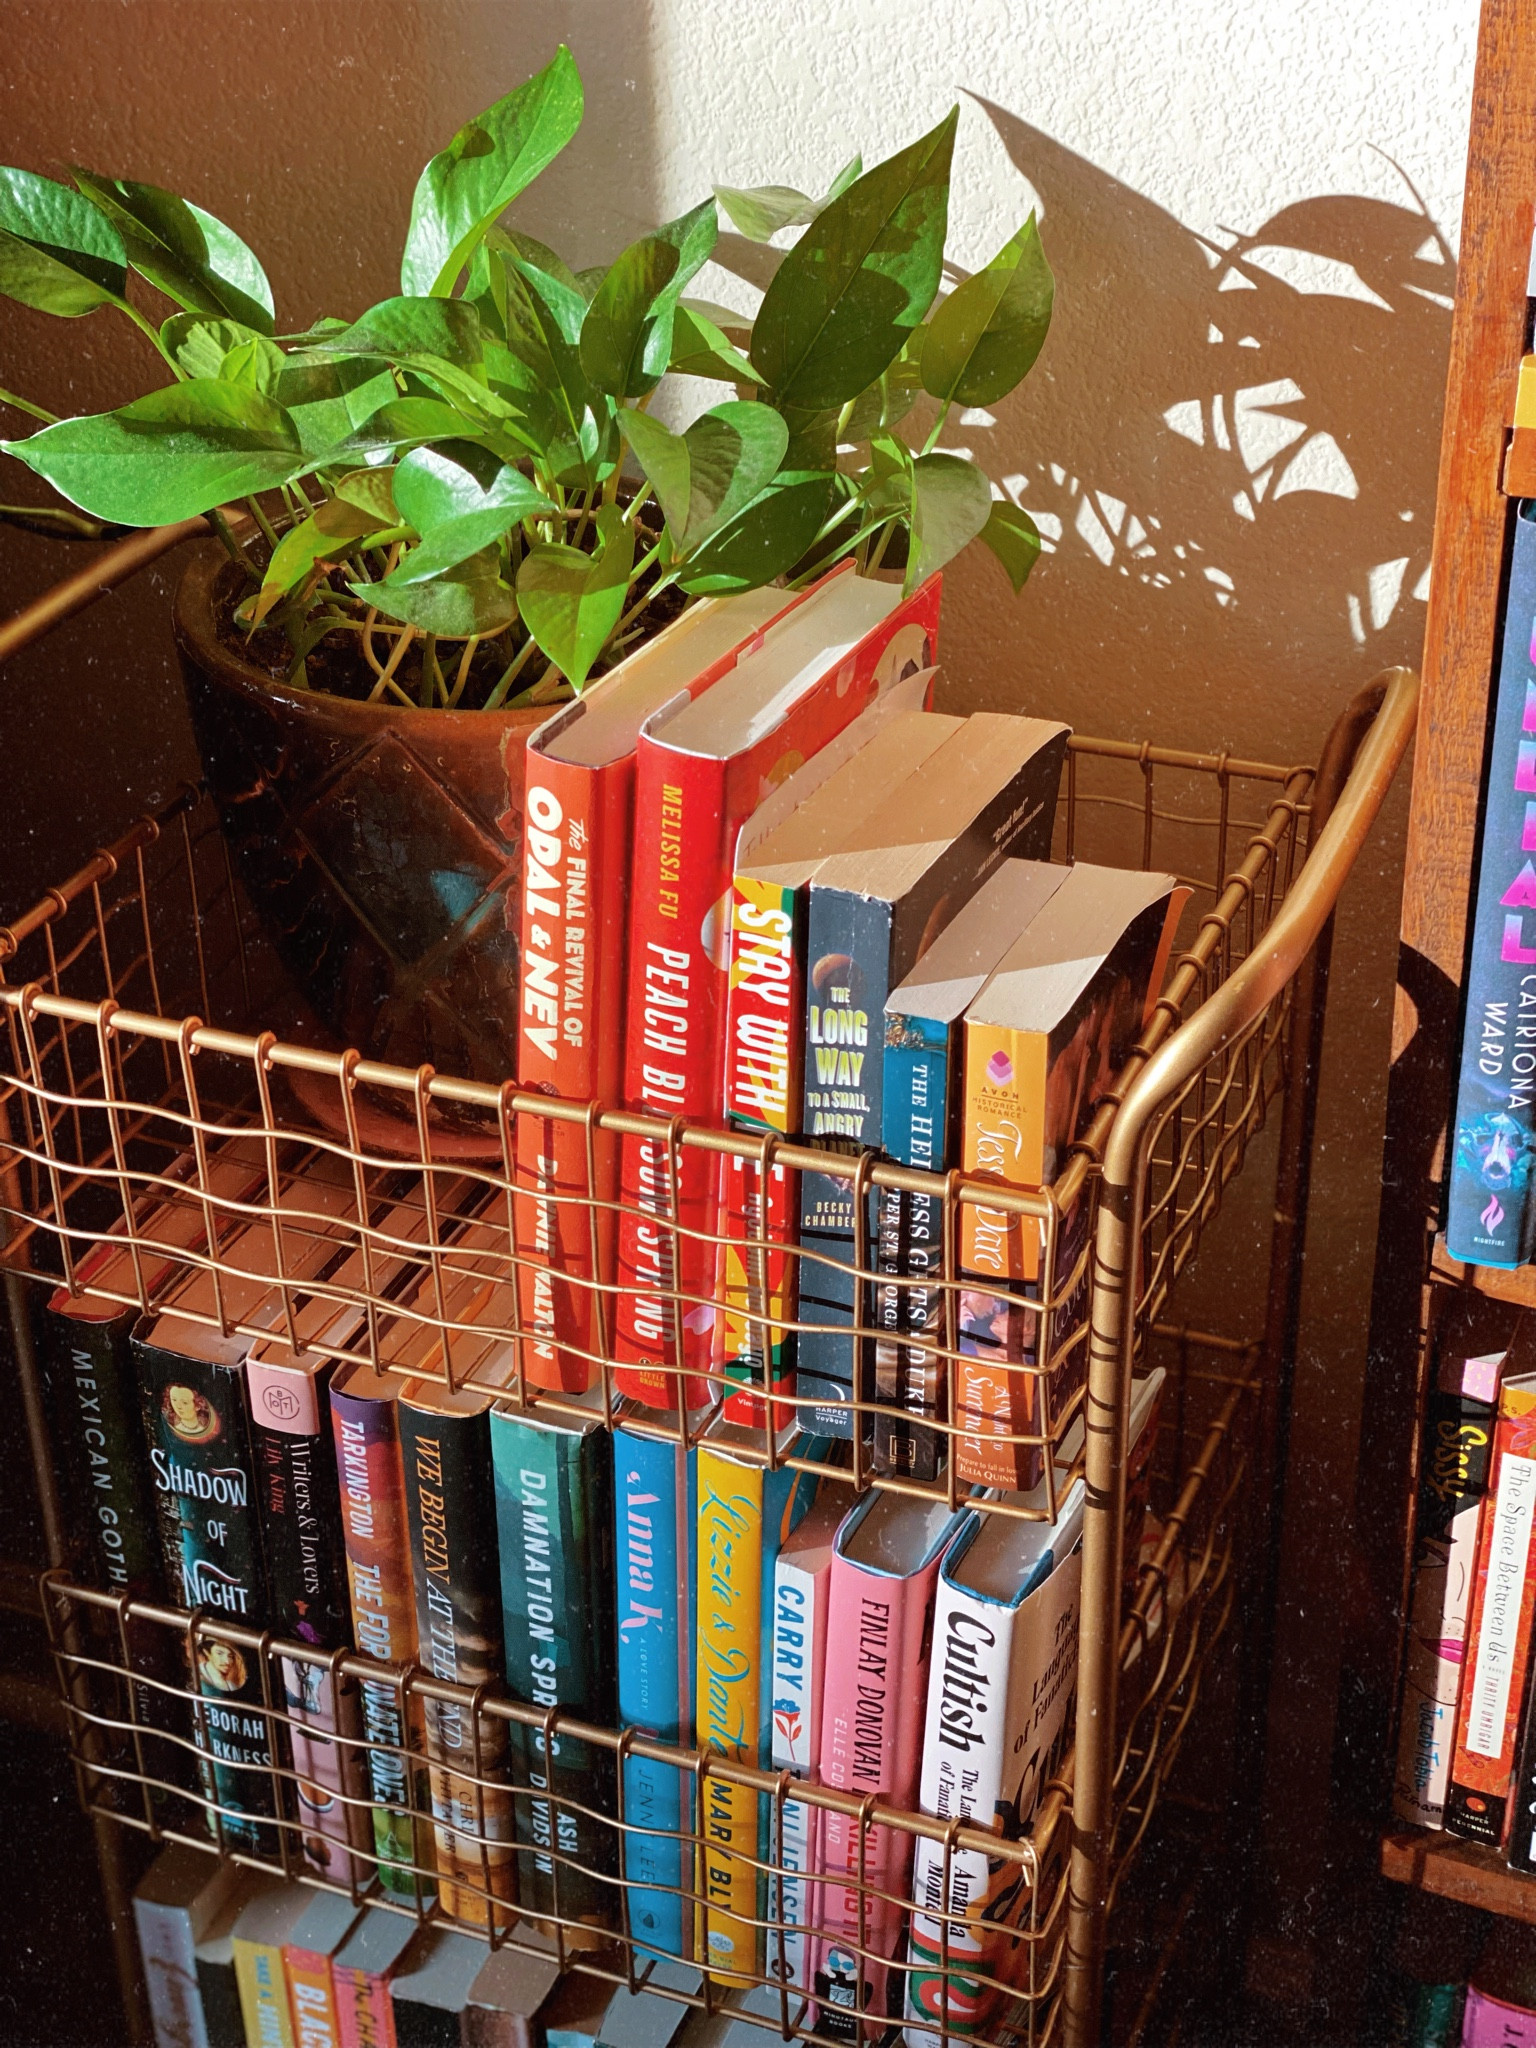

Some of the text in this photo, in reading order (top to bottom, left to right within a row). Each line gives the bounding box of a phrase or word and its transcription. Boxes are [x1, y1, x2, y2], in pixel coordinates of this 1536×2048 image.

[657, 783, 684, 920] MELISSA FU
[523, 785, 564, 1061] OPAL & NEV
[563, 817, 586, 1048] The FINAL REVIVAL OF
[737, 902, 794, 1007] STAY
[643, 942, 691, 1056] PEACH
[830, 986, 850, 1004] THE
[810, 1005, 868, 1047] LONG
[1478, 1001, 1509, 1076] WARD
[734, 1013, 789, 1115] WITH
[814, 1047, 865, 1087] WAY
[912, 1063, 929, 1109] THE
[807, 1090, 870, 1113] TO A SMALL,
[973, 1096, 1027, 1114] HISTORICAL
[977, 1104, 1022, 1120] ROMANCE
[981, 1086, 1020, 1100] AVON
[813, 1110, 864, 1138] ANGRY
[908, 1112, 933, 1240] HEIESS
[816, 1201, 852, 1215] BECKY
[973, 1203, 1019, 1270] Dare
[1473, 1236, 1506, 1248] NIGHTFIRE
[633, 1225, 677, 1343] SPRNG
[884, 1263, 899, 1332] GORGE
[909, 1248, 931, 1323] GTS
[71, 1348, 113, 1490] MEXICAN
[815, 1414, 848, 1426] Voyager
[994, 1385, 1011, 1402] A
[1501, 1403, 1521, 1416] P.S.
[151, 1448, 248, 1507] SHADOW
[340, 1418, 374, 1540] TARKINGTON
[415, 1435, 442, 1488] WE
[959, 1463, 1017, 1484] JULIA QUINN
[1426, 1419, 1488, 1502] Sissy
[1508, 1464, 1532, 1498] The
[269, 1473, 287, 1516] King
[289, 1440, 321, 1596] Writers & Lovers
[207, 1519, 228, 1548] OF
[418, 1487, 451, 1586] BEGIN
[519, 1467, 556, 1643] DAMNATION
[1499, 1501, 1526, 1556] Space
[352, 1559, 383, 1608] THE
[620, 1470, 664, 1645] Anna K
[182, 1559, 249, 1614] NIGHT
[427, 1578, 453, 1626] AT
[1487, 1560, 1520, 1642] Between
[700, 1479, 761, 1764] Lizzie & Dante
[776, 1583, 806, 1691] CARRY
[857, 1597, 890, 1682] FINLAY
[430, 1622, 458, 1684] THE
[639, 1637, 650, 1711] A LOVE STORY
[1486, 1641, 1509, 1664] Us
[135, 1682, 150, 1723] Silvia
[938, 1610, 996, 1753] Cultish
[1484, 1676, 1501, 1709] THRITY
[194, 1728, 272, 1766] HRKNESS
[832, 1716, 848, 1755] ELLE
[852, 1681, 887, 1786] DONOVAN
[1013, 1723, 1031, 1755] of
[1413, 1701, 1444, 1793] Jacob Tobia
[1476, 1711, 1496, 1751] UMRIGAR
[942, 1761, 956, 1778] of
[961, 1768, 979, 1792] The
[458, 1790, 474, 1835] CHRI
[529, 1771, 553, 1875] DVIDSN
[557, 1810, 578, 1853] ASH
[638, 1769, 656, 1881] JENN LEE
[823, 2009, 857, 2024] MINOTAU
